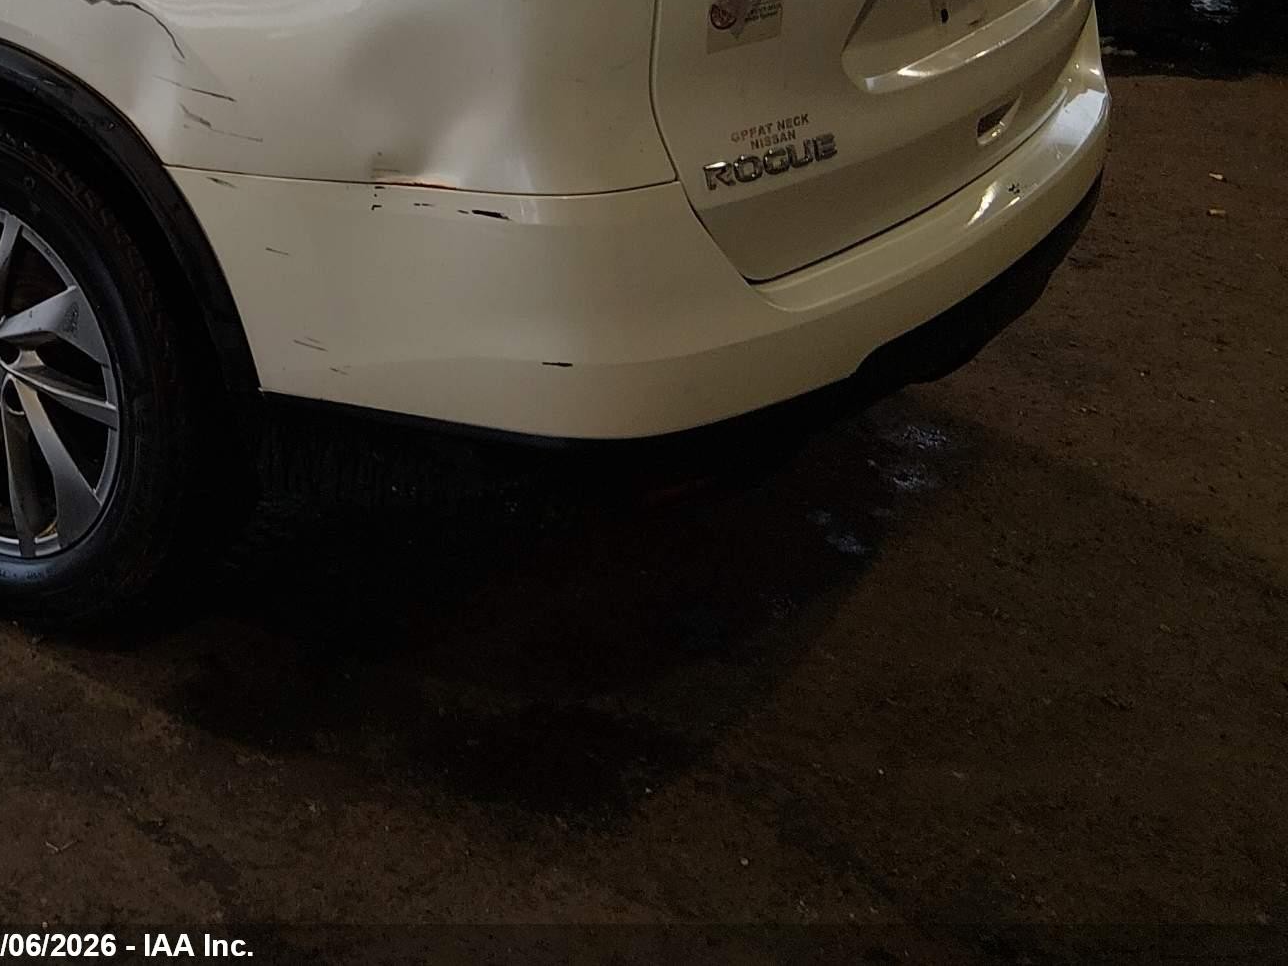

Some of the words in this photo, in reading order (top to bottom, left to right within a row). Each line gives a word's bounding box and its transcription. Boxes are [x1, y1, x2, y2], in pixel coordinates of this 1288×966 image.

[776, 113, 810, 132] NECK
[750, 129, 797, 150] NISSAN
[703, 133, 838, 191] ROGUE
